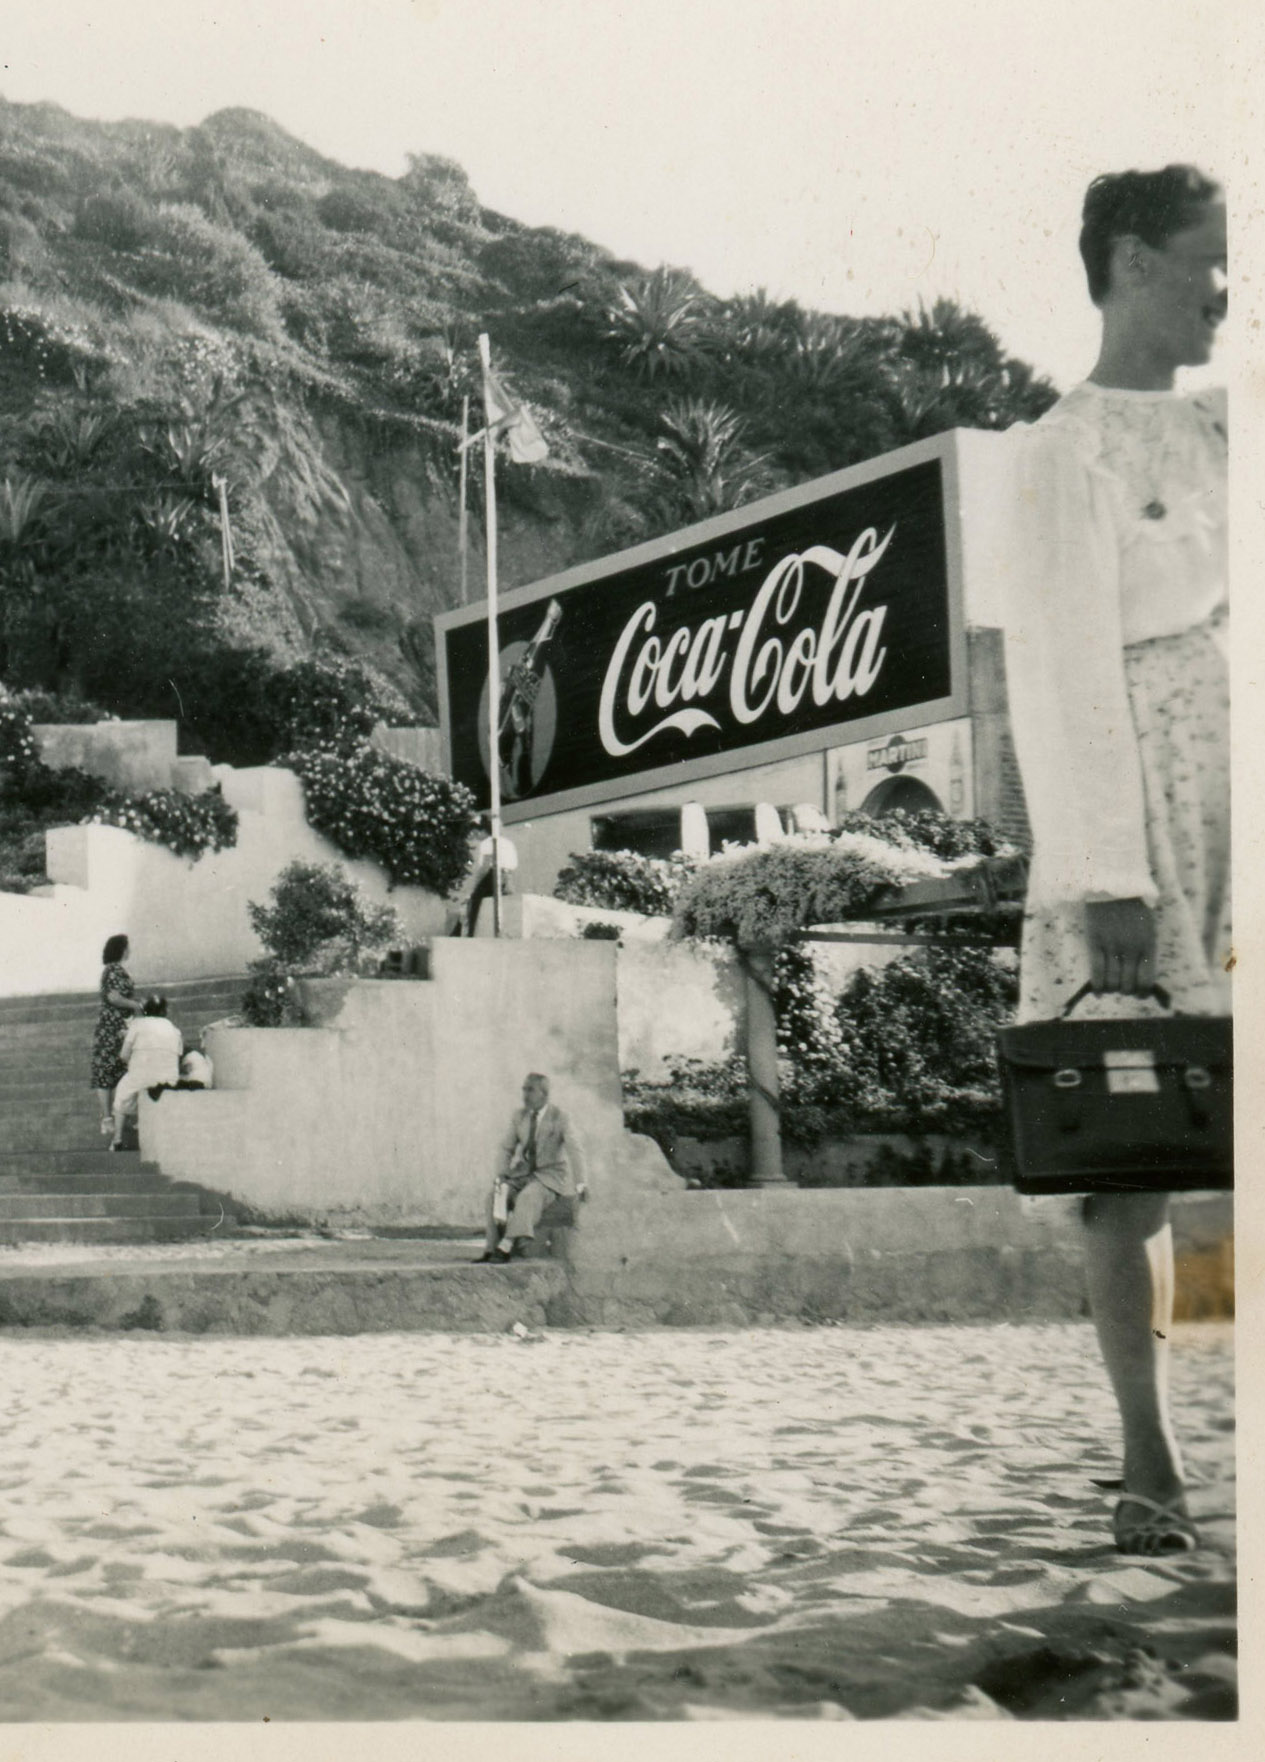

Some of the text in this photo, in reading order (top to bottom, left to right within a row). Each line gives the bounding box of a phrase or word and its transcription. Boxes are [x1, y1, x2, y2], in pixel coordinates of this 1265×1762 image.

[665, 537, 766, 597] TOME
[599, 522, 896, 756] Coca-Cola
[867, 739, 927, 770] MARTINI
